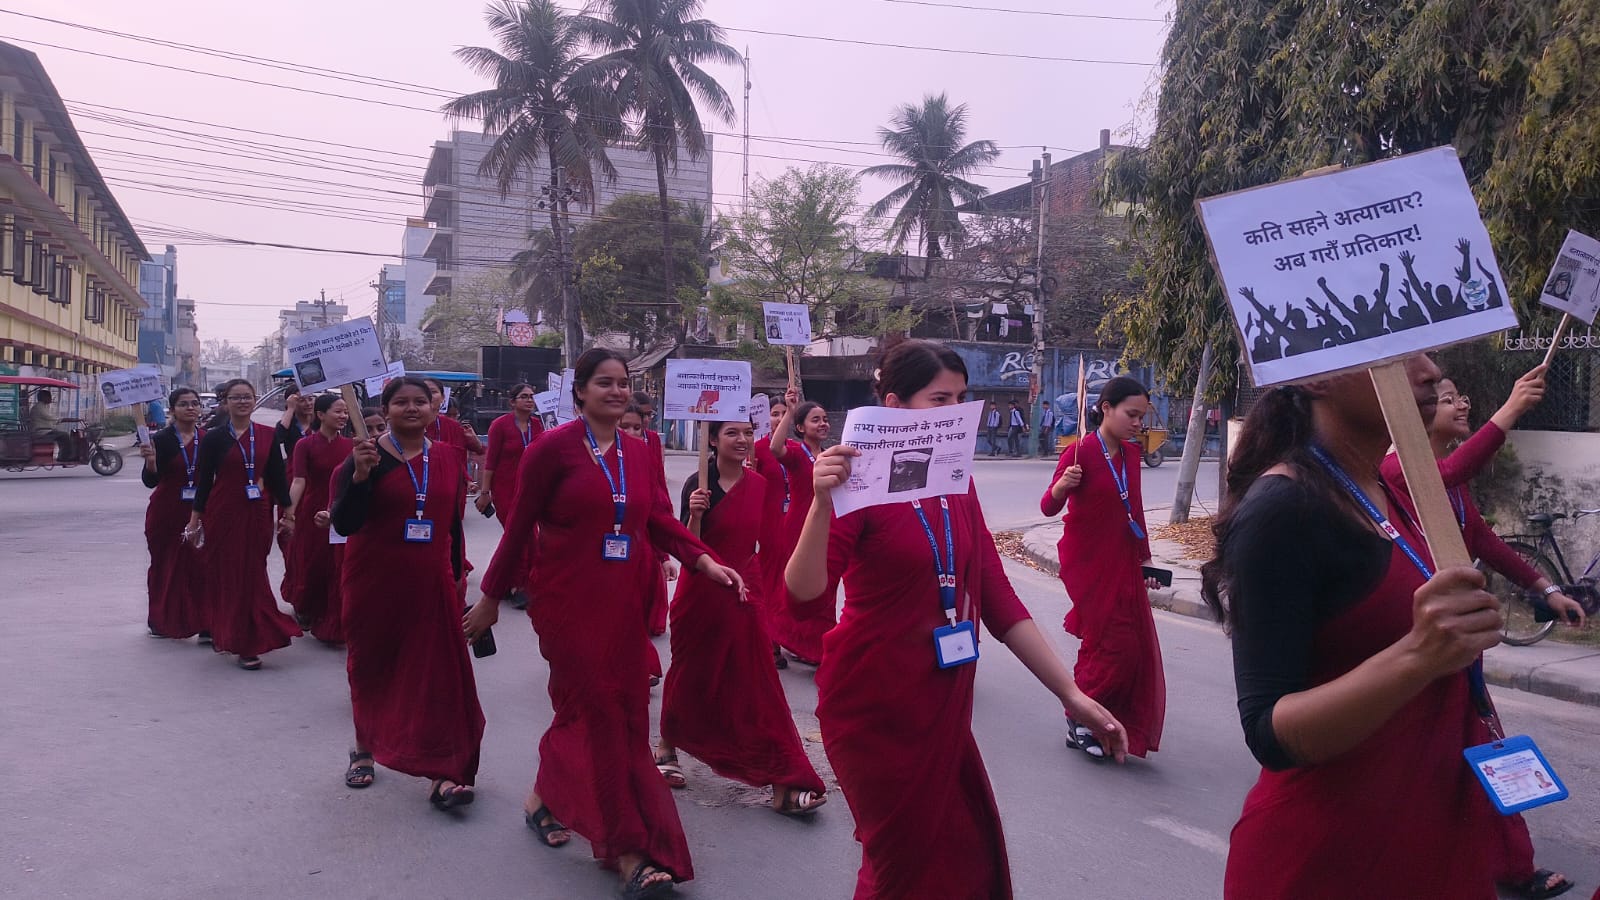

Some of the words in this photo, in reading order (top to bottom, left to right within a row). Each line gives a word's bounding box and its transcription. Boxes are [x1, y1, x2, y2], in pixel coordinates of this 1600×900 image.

[1243, 221, 1283, 247] कति
[1287, 211, 1331, 239] सहने
[1333, 190, 1425, 227] अत्याचार?
[1273, 252, 1307, 273] अब
[1342, 223, 1423, 259] प्रतिकार!
[853, 423, 875, 434] सभ्य
[877, 421, 917, 434] समाजले
[920, 420, 930, 431] के
[933, 419, 954, 429] भन्छ
[908, 434, 934, 447] फाँसी
[936, 434, 942, 444] दे
[946, 432, 966, 442] भन्छ
